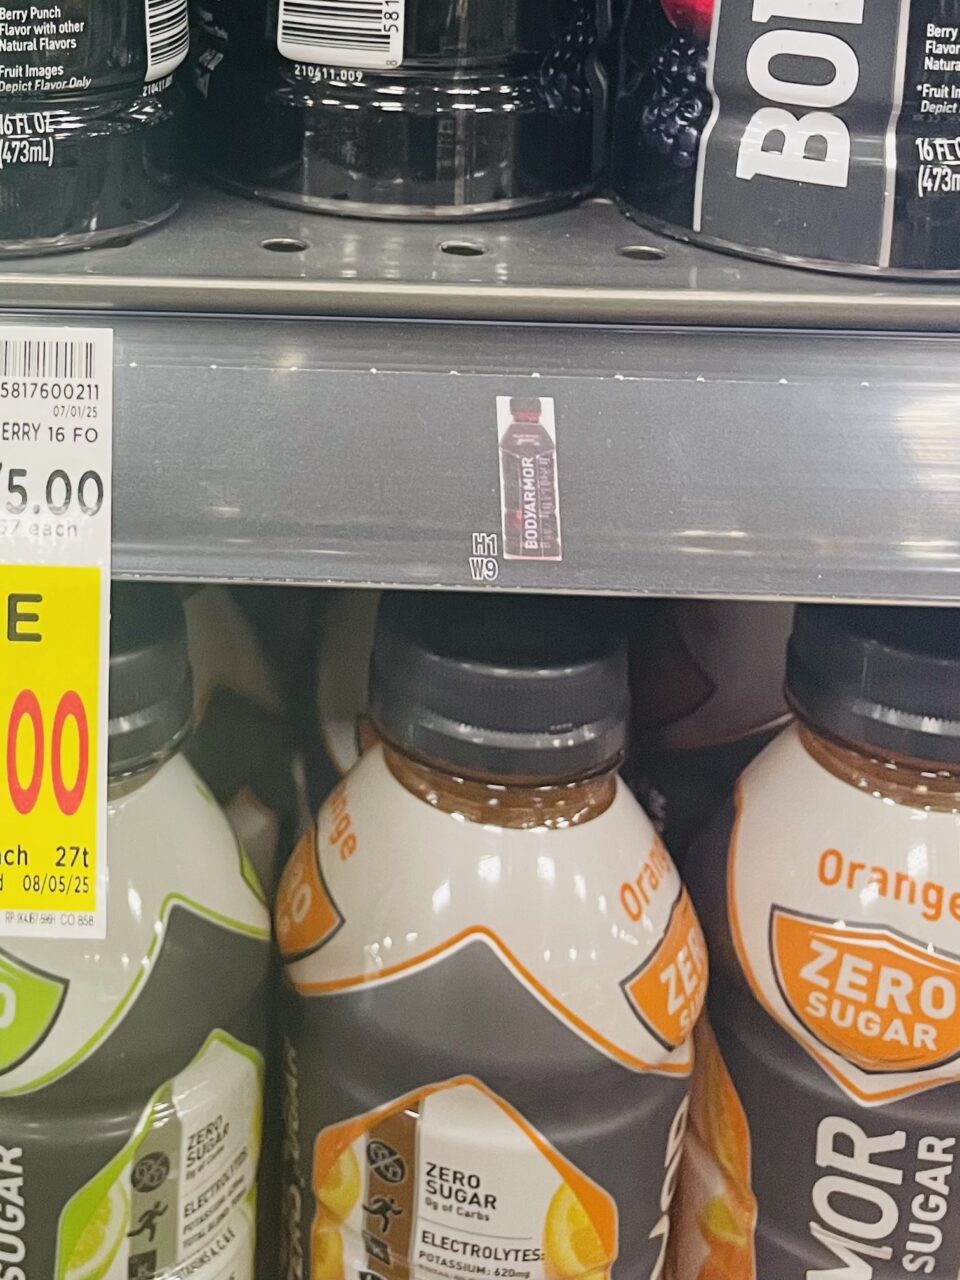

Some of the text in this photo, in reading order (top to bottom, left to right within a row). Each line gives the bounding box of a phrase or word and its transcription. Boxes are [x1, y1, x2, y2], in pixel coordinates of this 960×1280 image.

[0, 6, 61, 22] Berry Punch
[0, 21, 84, 36] Flavor with other
[927, 24, 958, 41] Berry
[0, 38, 77, 52] Natural Flavors
[25, 65, 64, 79] Images
[34, 81, 64, 91] Flavor
[69, 77, 92, 89] Only
[921, 101, 956, 114] Depict
[16, 116, 32, 134] FL
[34, 112, 54, 133] OZ
[915, 138, 933, 161] 16
[53, 406, 98, 418] 07/01/25
[48, 427, 65, 442] 16
[74, 428, 98, 443] FO
[521, 456, 539, 550] BODYARMOR
[29, 521, 78, 537] each
[472, 533, 497, 556] H1
[469, 557, 498, 581] W9
[55, 846, 89, 868] 27t
[23, 875, 89, 896] 08/05/25
[801, 939, 956, 1020] ZERO
[805, 991, 937, 1051] SUGAR
[425, 1162, 481, 1189] ZERO
[425, 1179, 497, 1210] SUGAR
[902, 1135, 957, 1274] SUGAR
[457, 1207, 490, 1221] Carbs
[422, 1230, 545, 1262] ELECTROLYTES:
